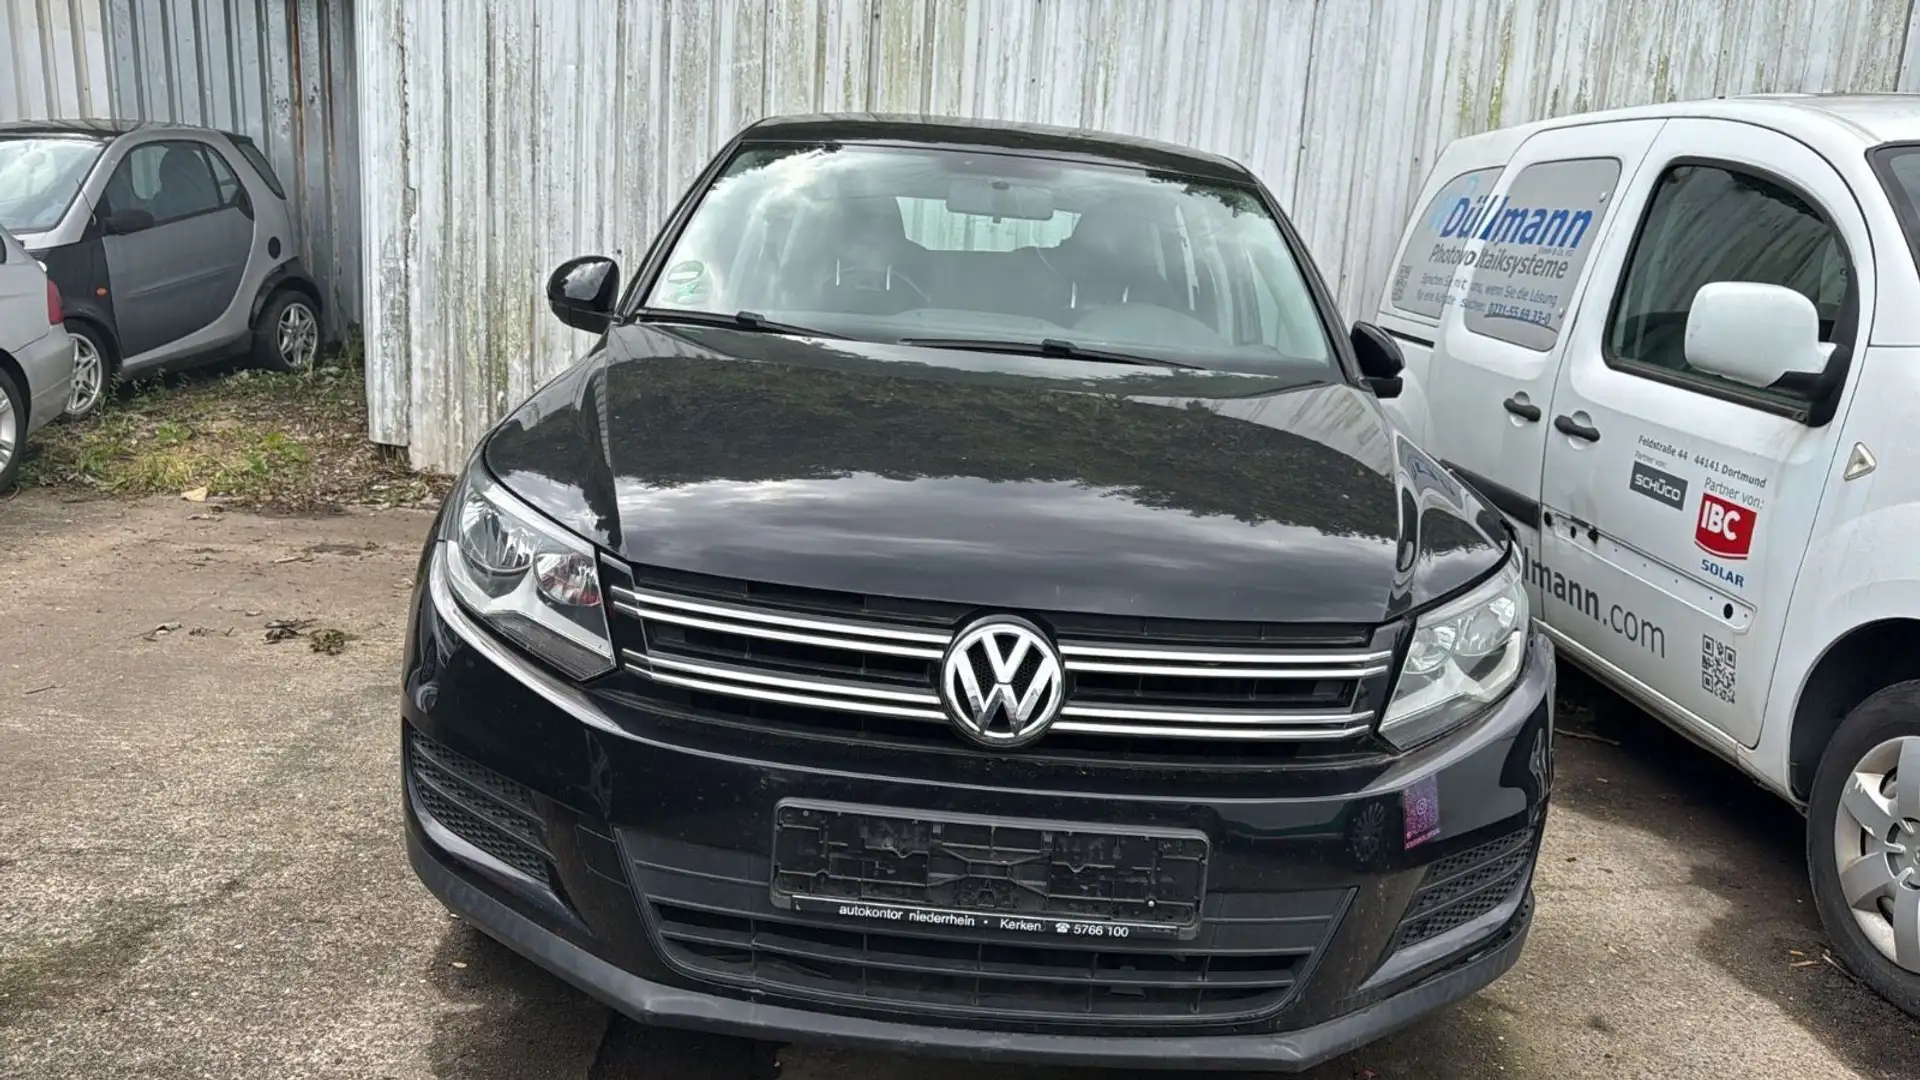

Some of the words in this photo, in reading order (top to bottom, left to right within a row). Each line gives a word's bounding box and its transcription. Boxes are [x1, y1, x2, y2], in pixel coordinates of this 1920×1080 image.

[1440, 195, 1593, 248] Düllmann
[1638, 435, 1677, 457] Feldstraße
[1677, 449, 1688, 461] 44
[1694, 455, 1720, 473] 44141
[1721, 464, 1768, 489] Dortmund
[1635, 473, 1681, 501] SCHÜCO
[1704, 477, 1741, 500] Partner
[1741, 492, 1765, 510] von:
[1701, 500, 1741, 541] IBC
[1701, 559, 1744, 588] SOLAR
[839, 904, 903, 920] autokontor
[908, 910, 976, 927] niederrhein
[1000, 918, 1043, 932] Kerken
[1073, 923, 1104, 937] 5766
[1107, 926, 1130, 938] 100
